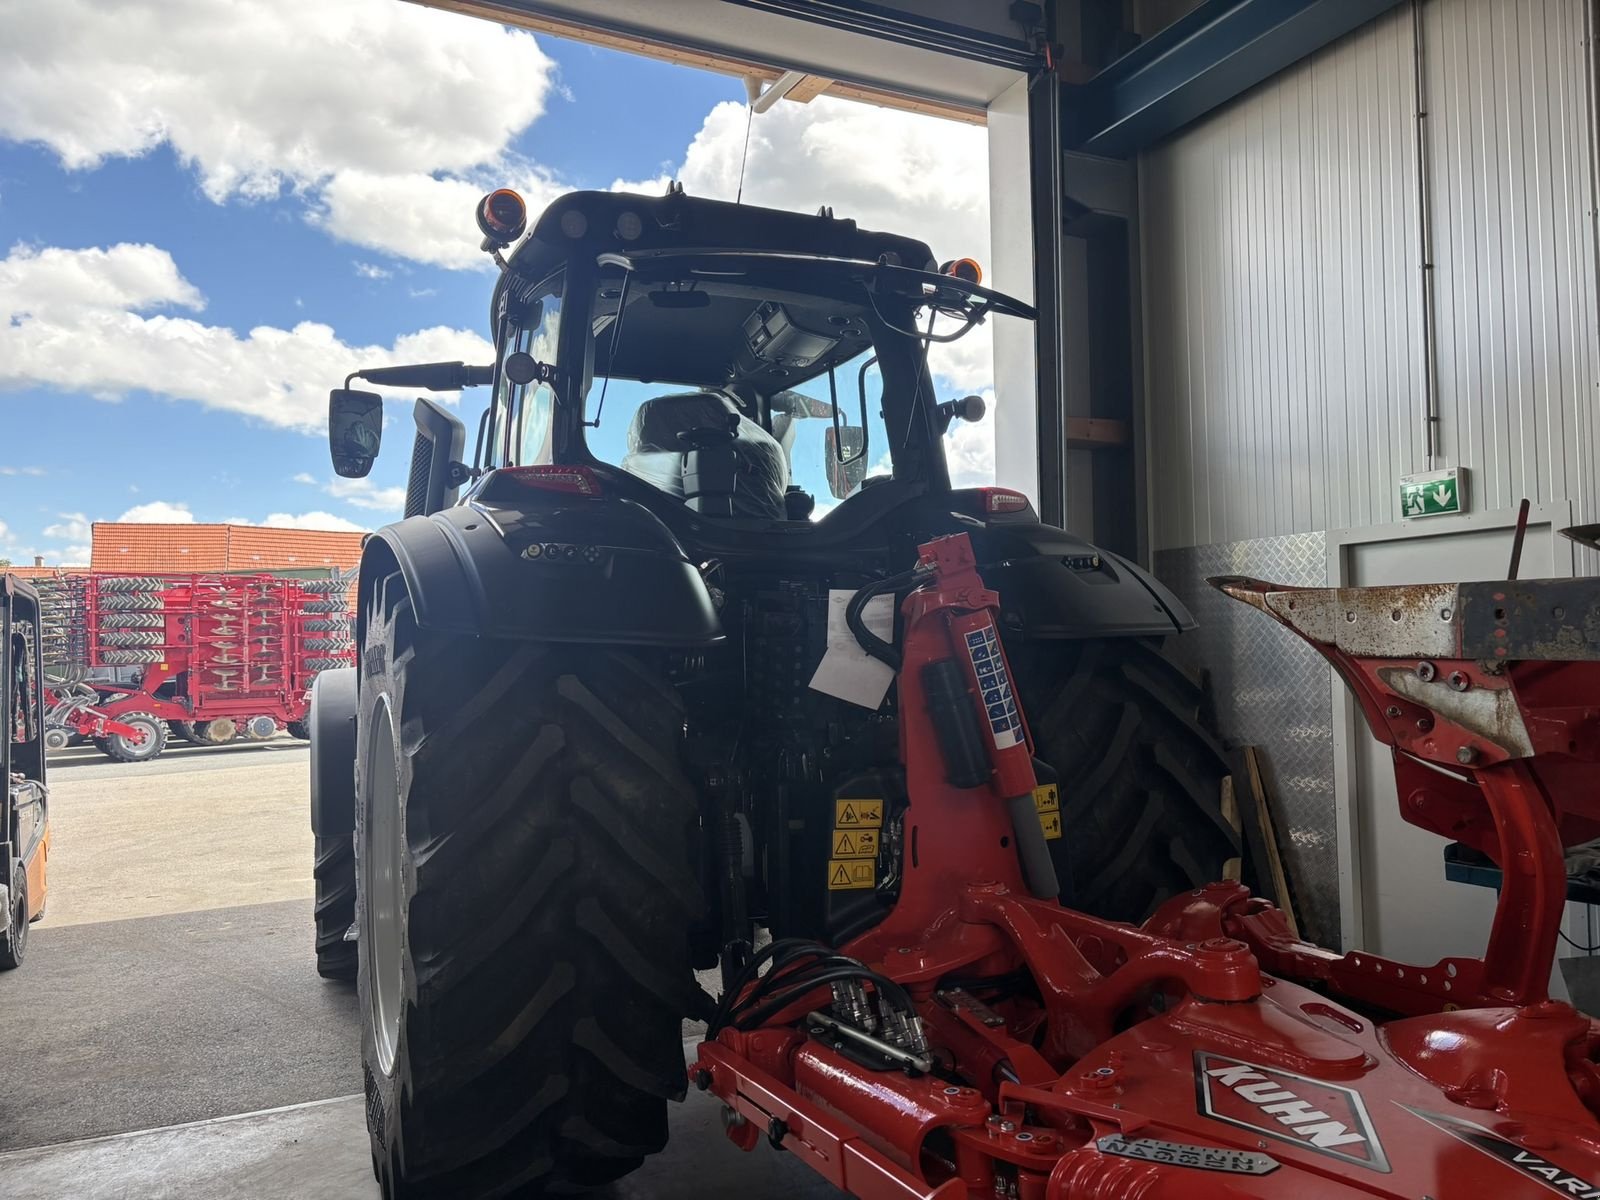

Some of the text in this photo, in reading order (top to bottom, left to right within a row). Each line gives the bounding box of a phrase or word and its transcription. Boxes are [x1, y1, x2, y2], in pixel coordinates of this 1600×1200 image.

[1204, 1064, 1368, 1149] KUHN
[1129, 1143, 1154, 1158] 14
[1154, 1147, 1177, 1161] 16
[1178, 1150, 1201, 1165] 18
[1204, 1153, 1226, 1168] 20
[1232, 1156, 1254, 1171] 22
